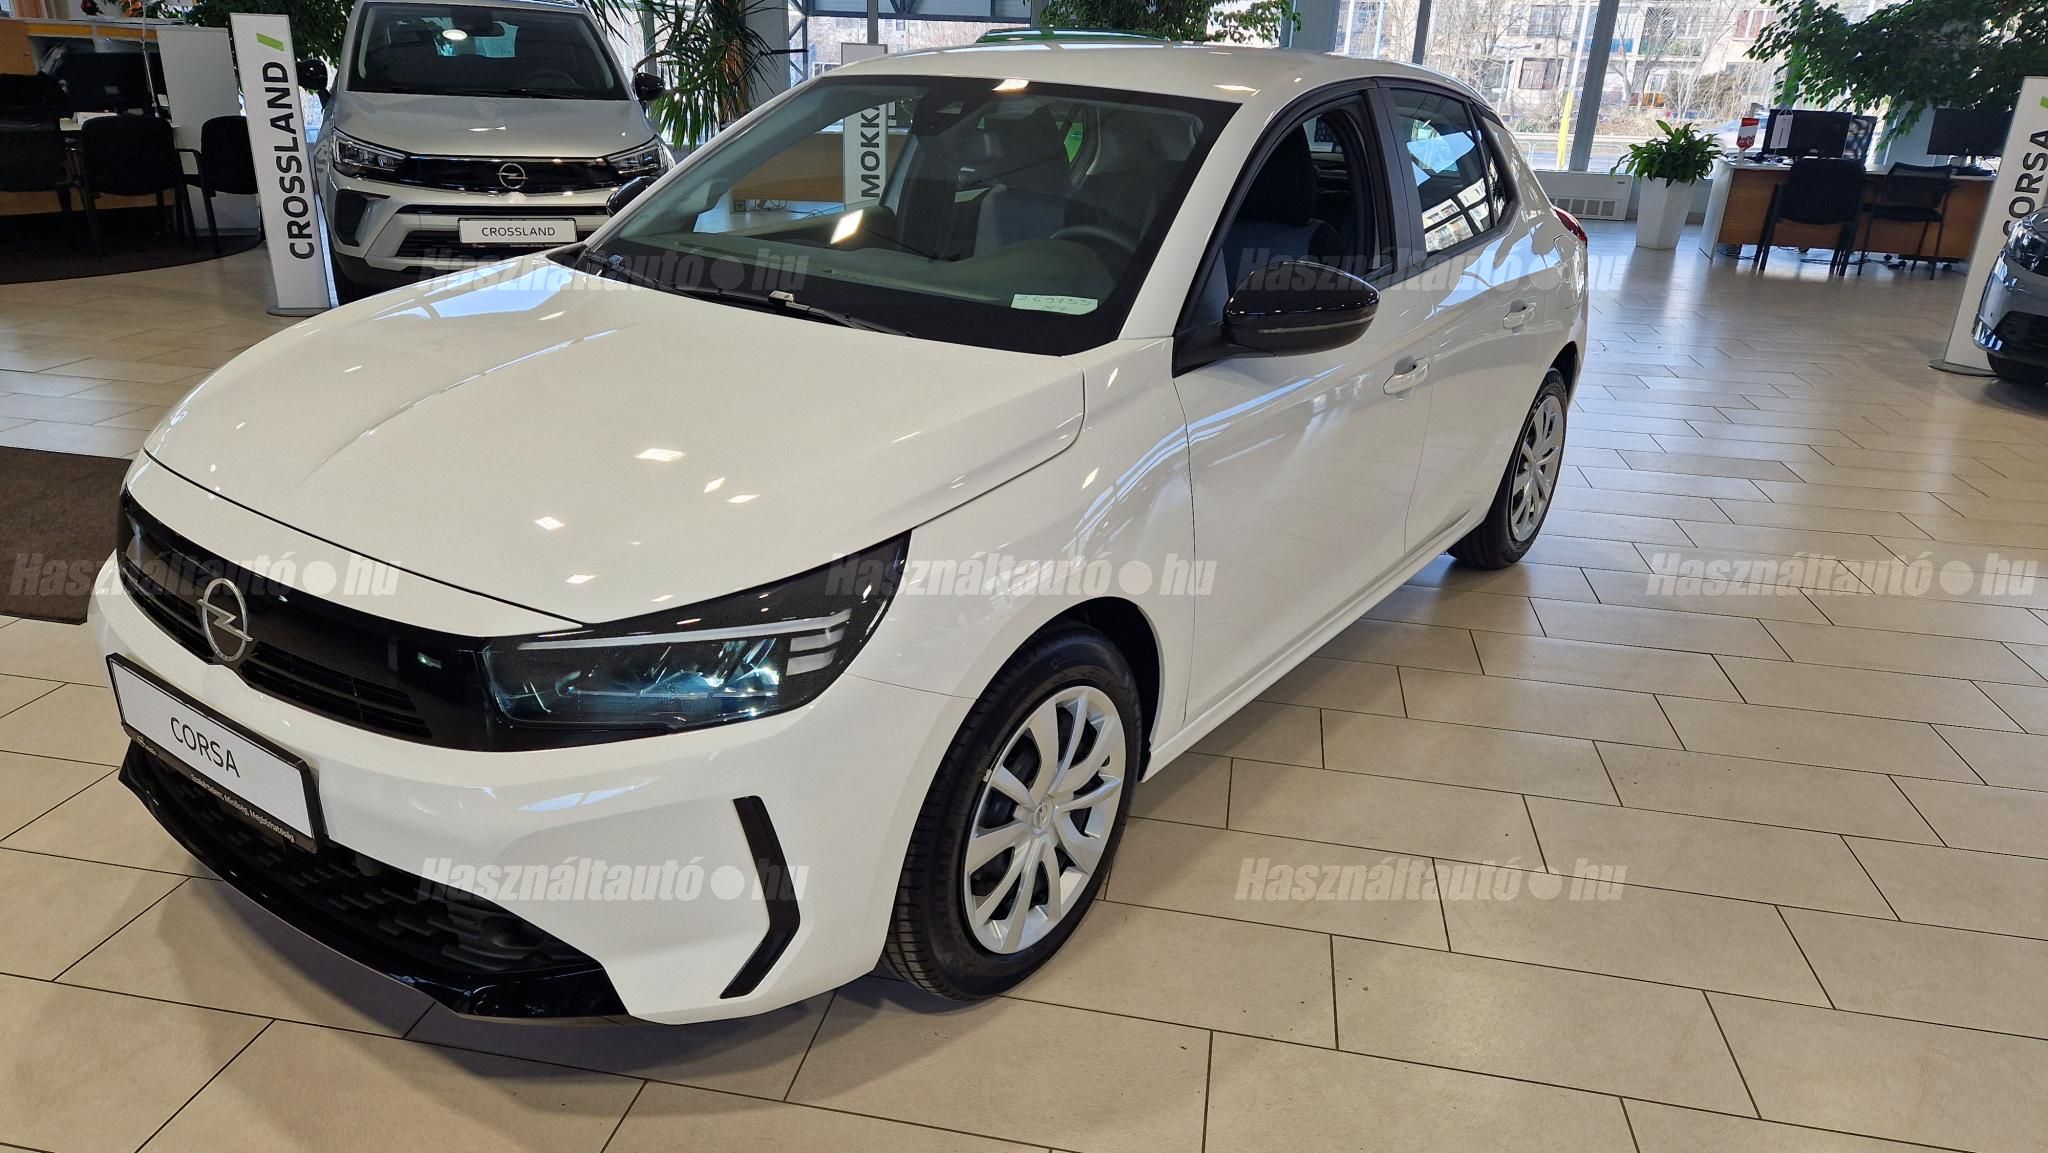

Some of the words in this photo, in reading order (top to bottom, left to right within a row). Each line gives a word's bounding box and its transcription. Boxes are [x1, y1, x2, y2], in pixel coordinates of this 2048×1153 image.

[261, 61, 315, 259] CROSSLAND
[481, 227, 556, 237] CROSSLAND
[170, 717, 240, 778] CORSA
